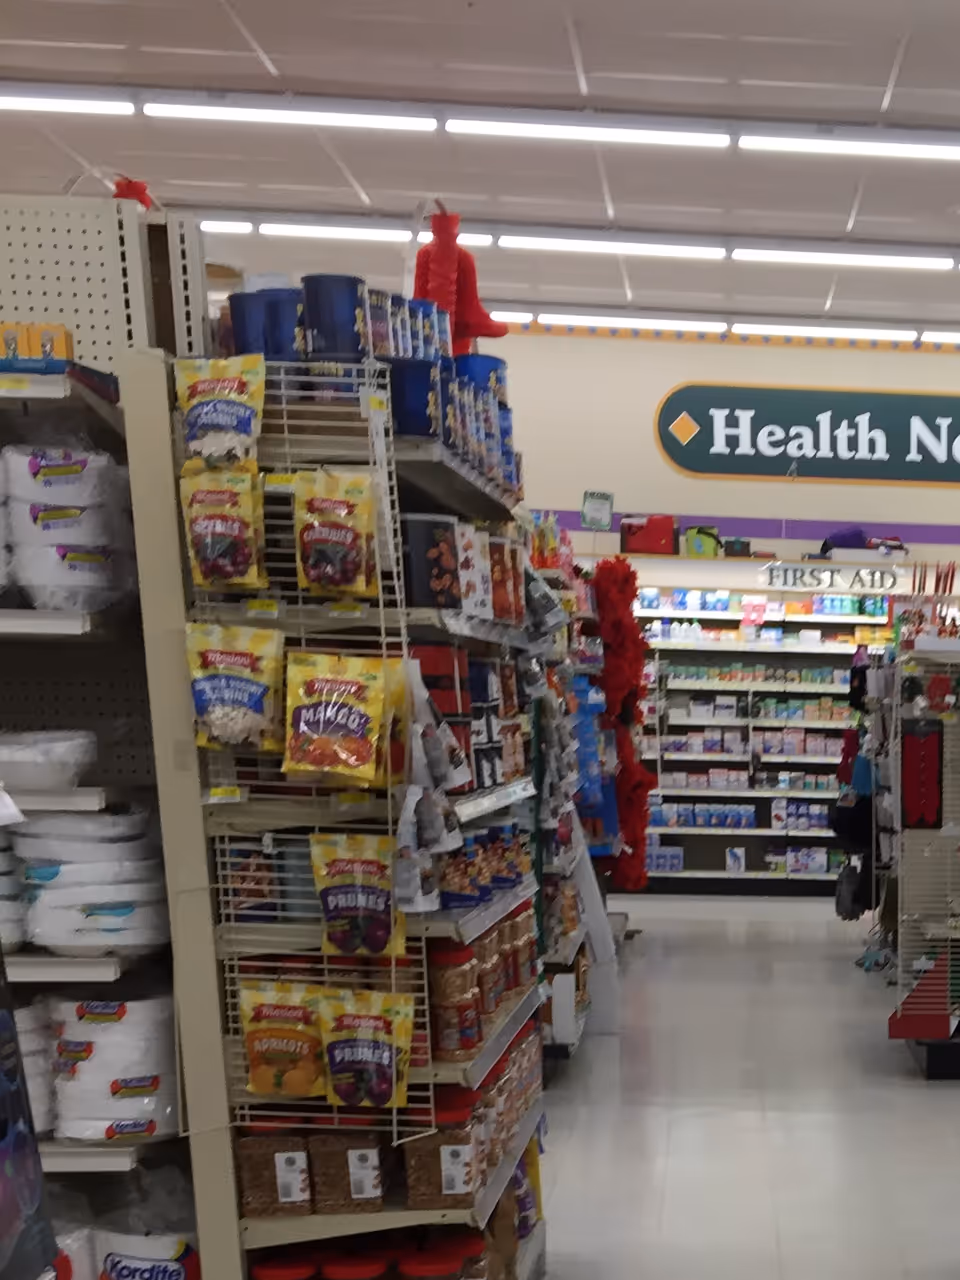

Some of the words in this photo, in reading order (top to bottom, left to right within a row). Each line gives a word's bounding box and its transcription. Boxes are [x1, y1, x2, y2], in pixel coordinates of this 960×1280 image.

[709, 408, 889, 461] Health
[767, 566, 841, 588] FIRST
[849, 568, 897, 590] AID
[300, 706, 361, 729] MANGO
[327, 893, 387, 911] PRUNES
[253, 1037, 310, 1056] APRICOTS
[334, 1047, 391, 1066] PRUNES
